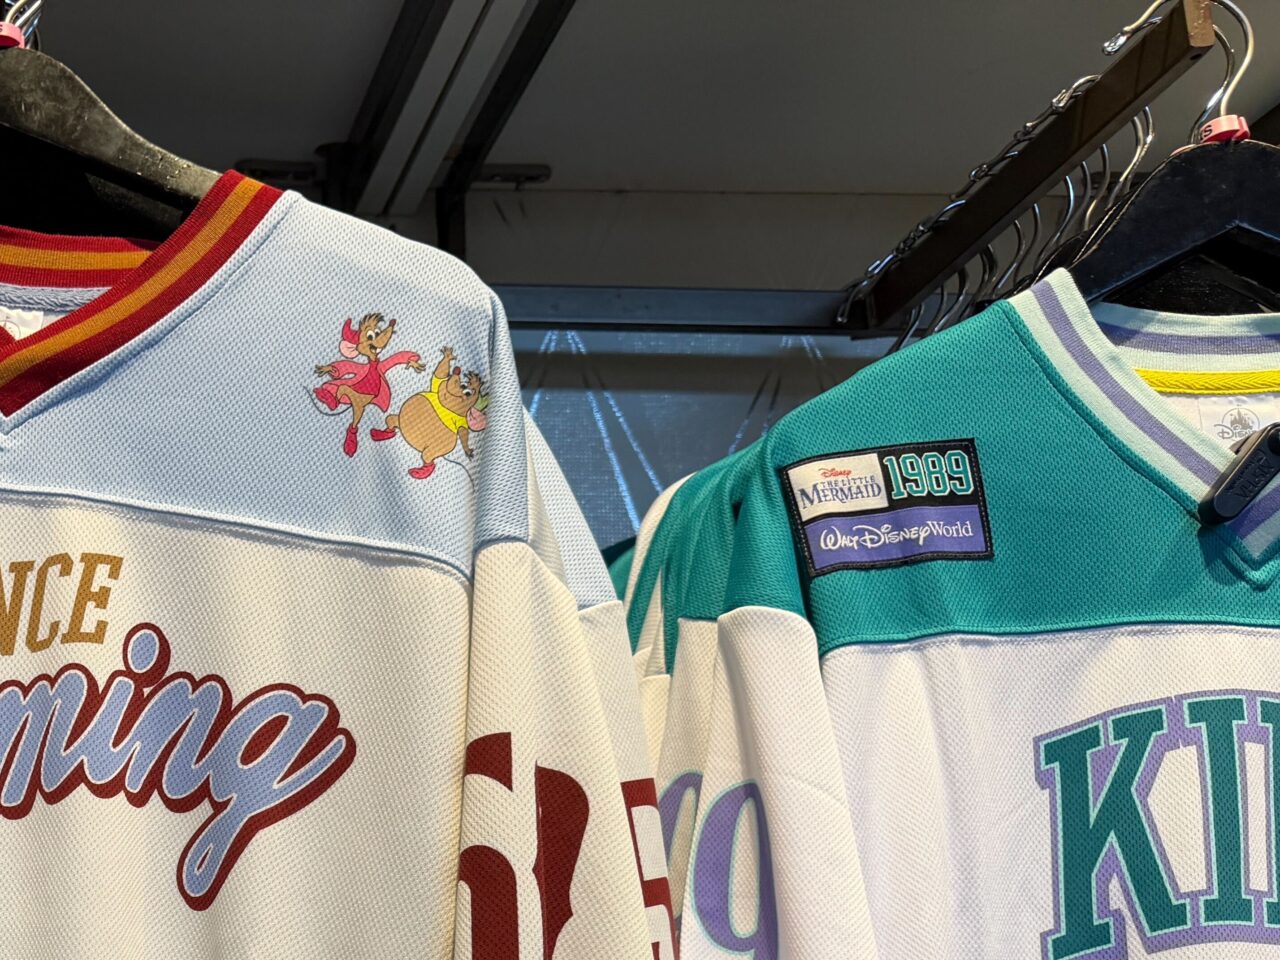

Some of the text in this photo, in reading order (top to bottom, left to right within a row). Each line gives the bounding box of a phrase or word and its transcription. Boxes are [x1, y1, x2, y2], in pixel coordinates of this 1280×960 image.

[820, 475, 877, 489] THE LITTLE
[883, 449, 975, 500] 1989
[798, 482, 882, 509] MERMAID
[928, 520, 974, 538] World
